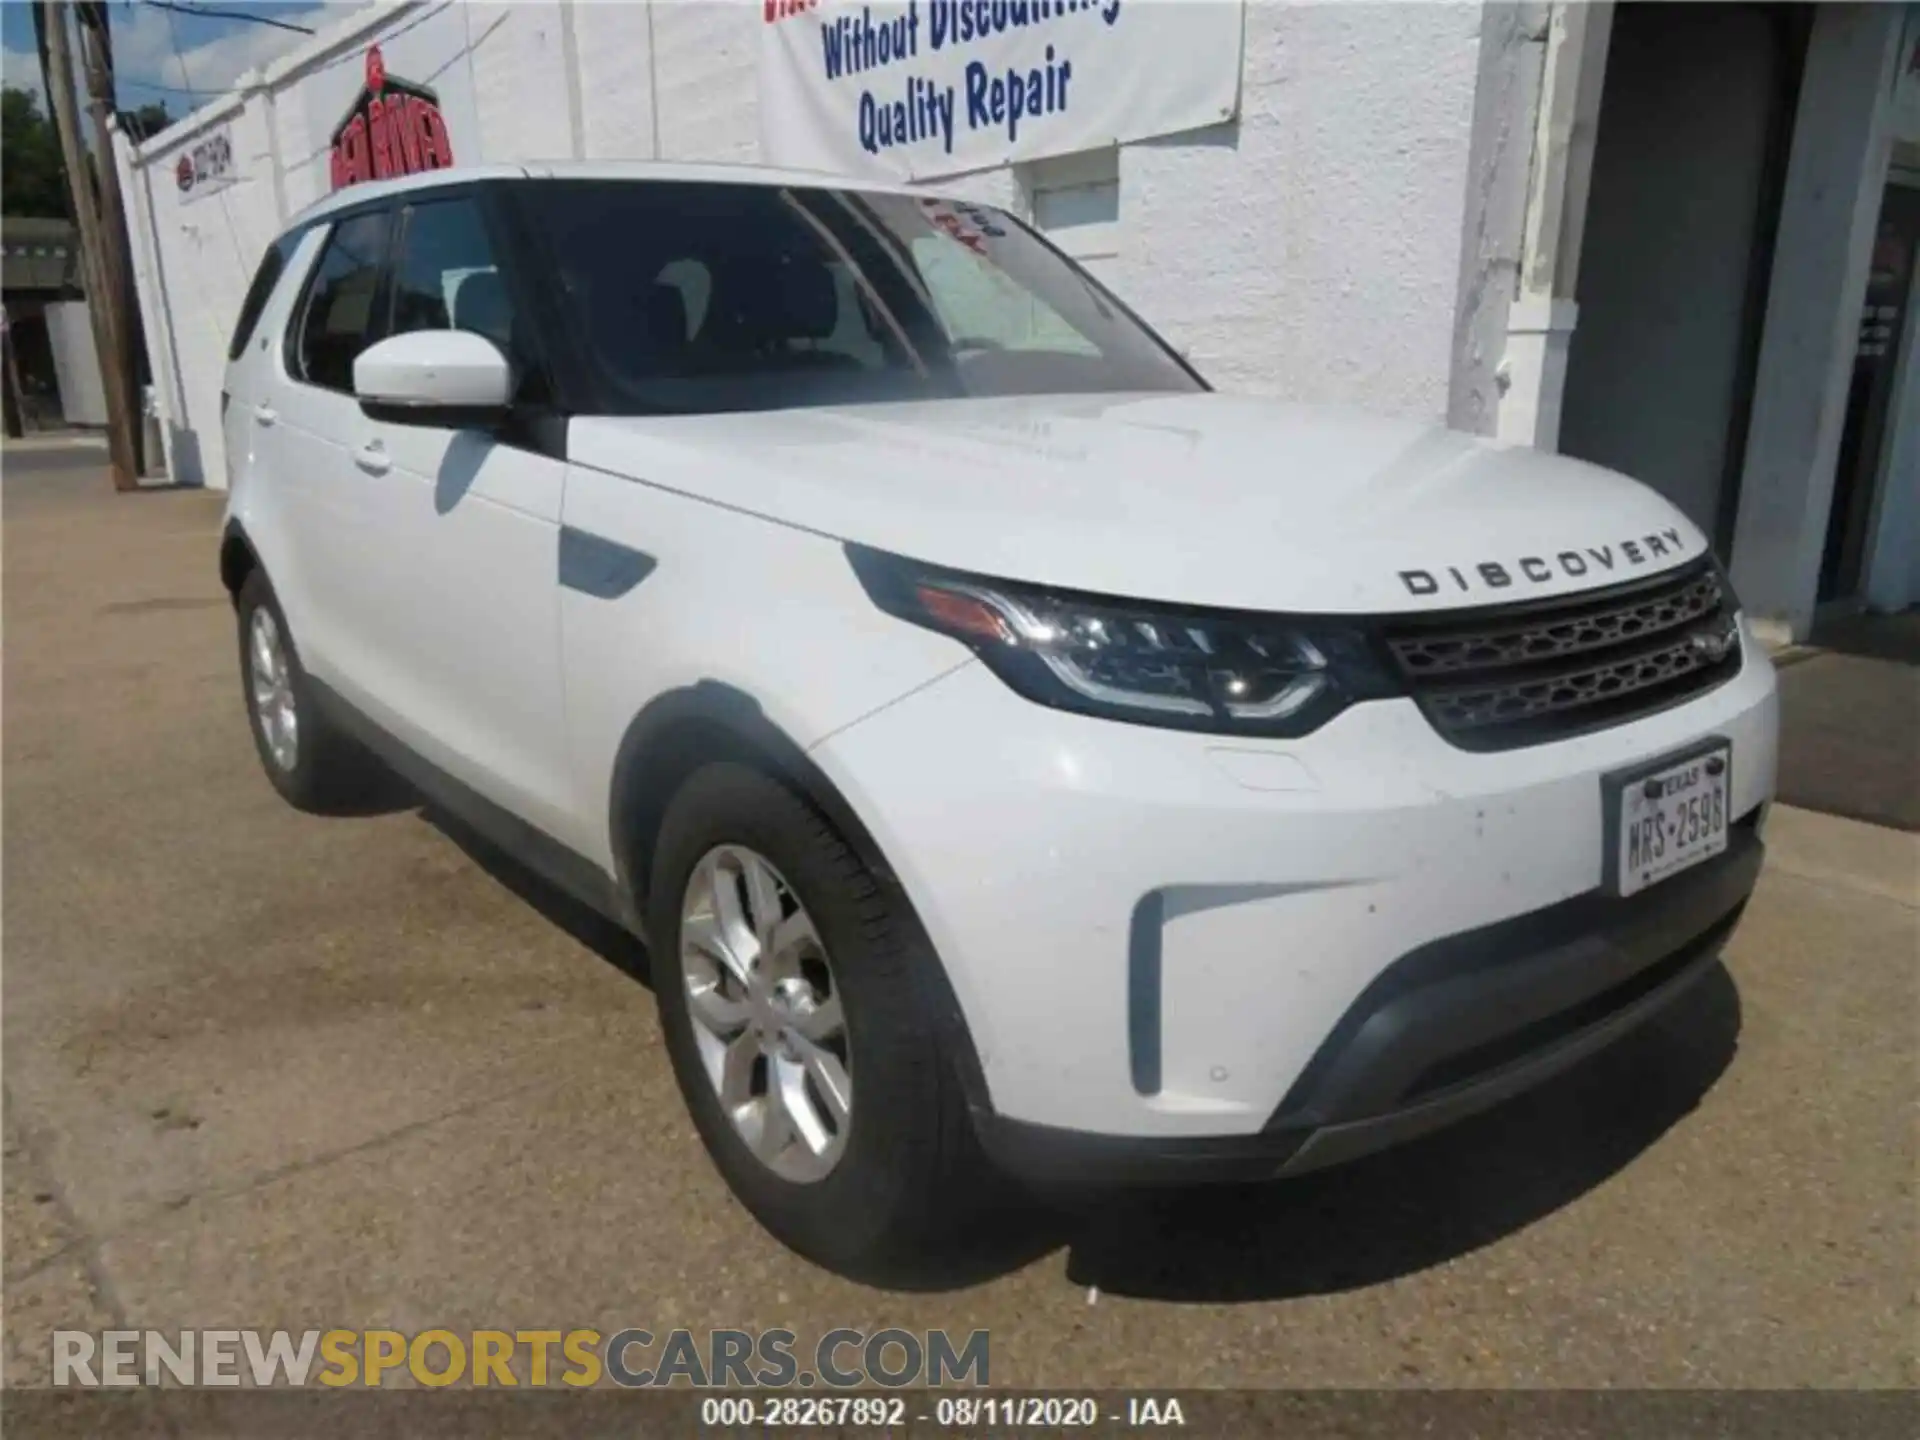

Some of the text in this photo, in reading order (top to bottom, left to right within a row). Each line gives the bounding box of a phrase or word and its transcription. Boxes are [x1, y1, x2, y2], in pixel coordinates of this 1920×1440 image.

[821, 0, 1120, 80] Without Discou
[859, 44, 1071, 154] Quality Repair
[1399, 528, 1684, 595] DISCOVERY
